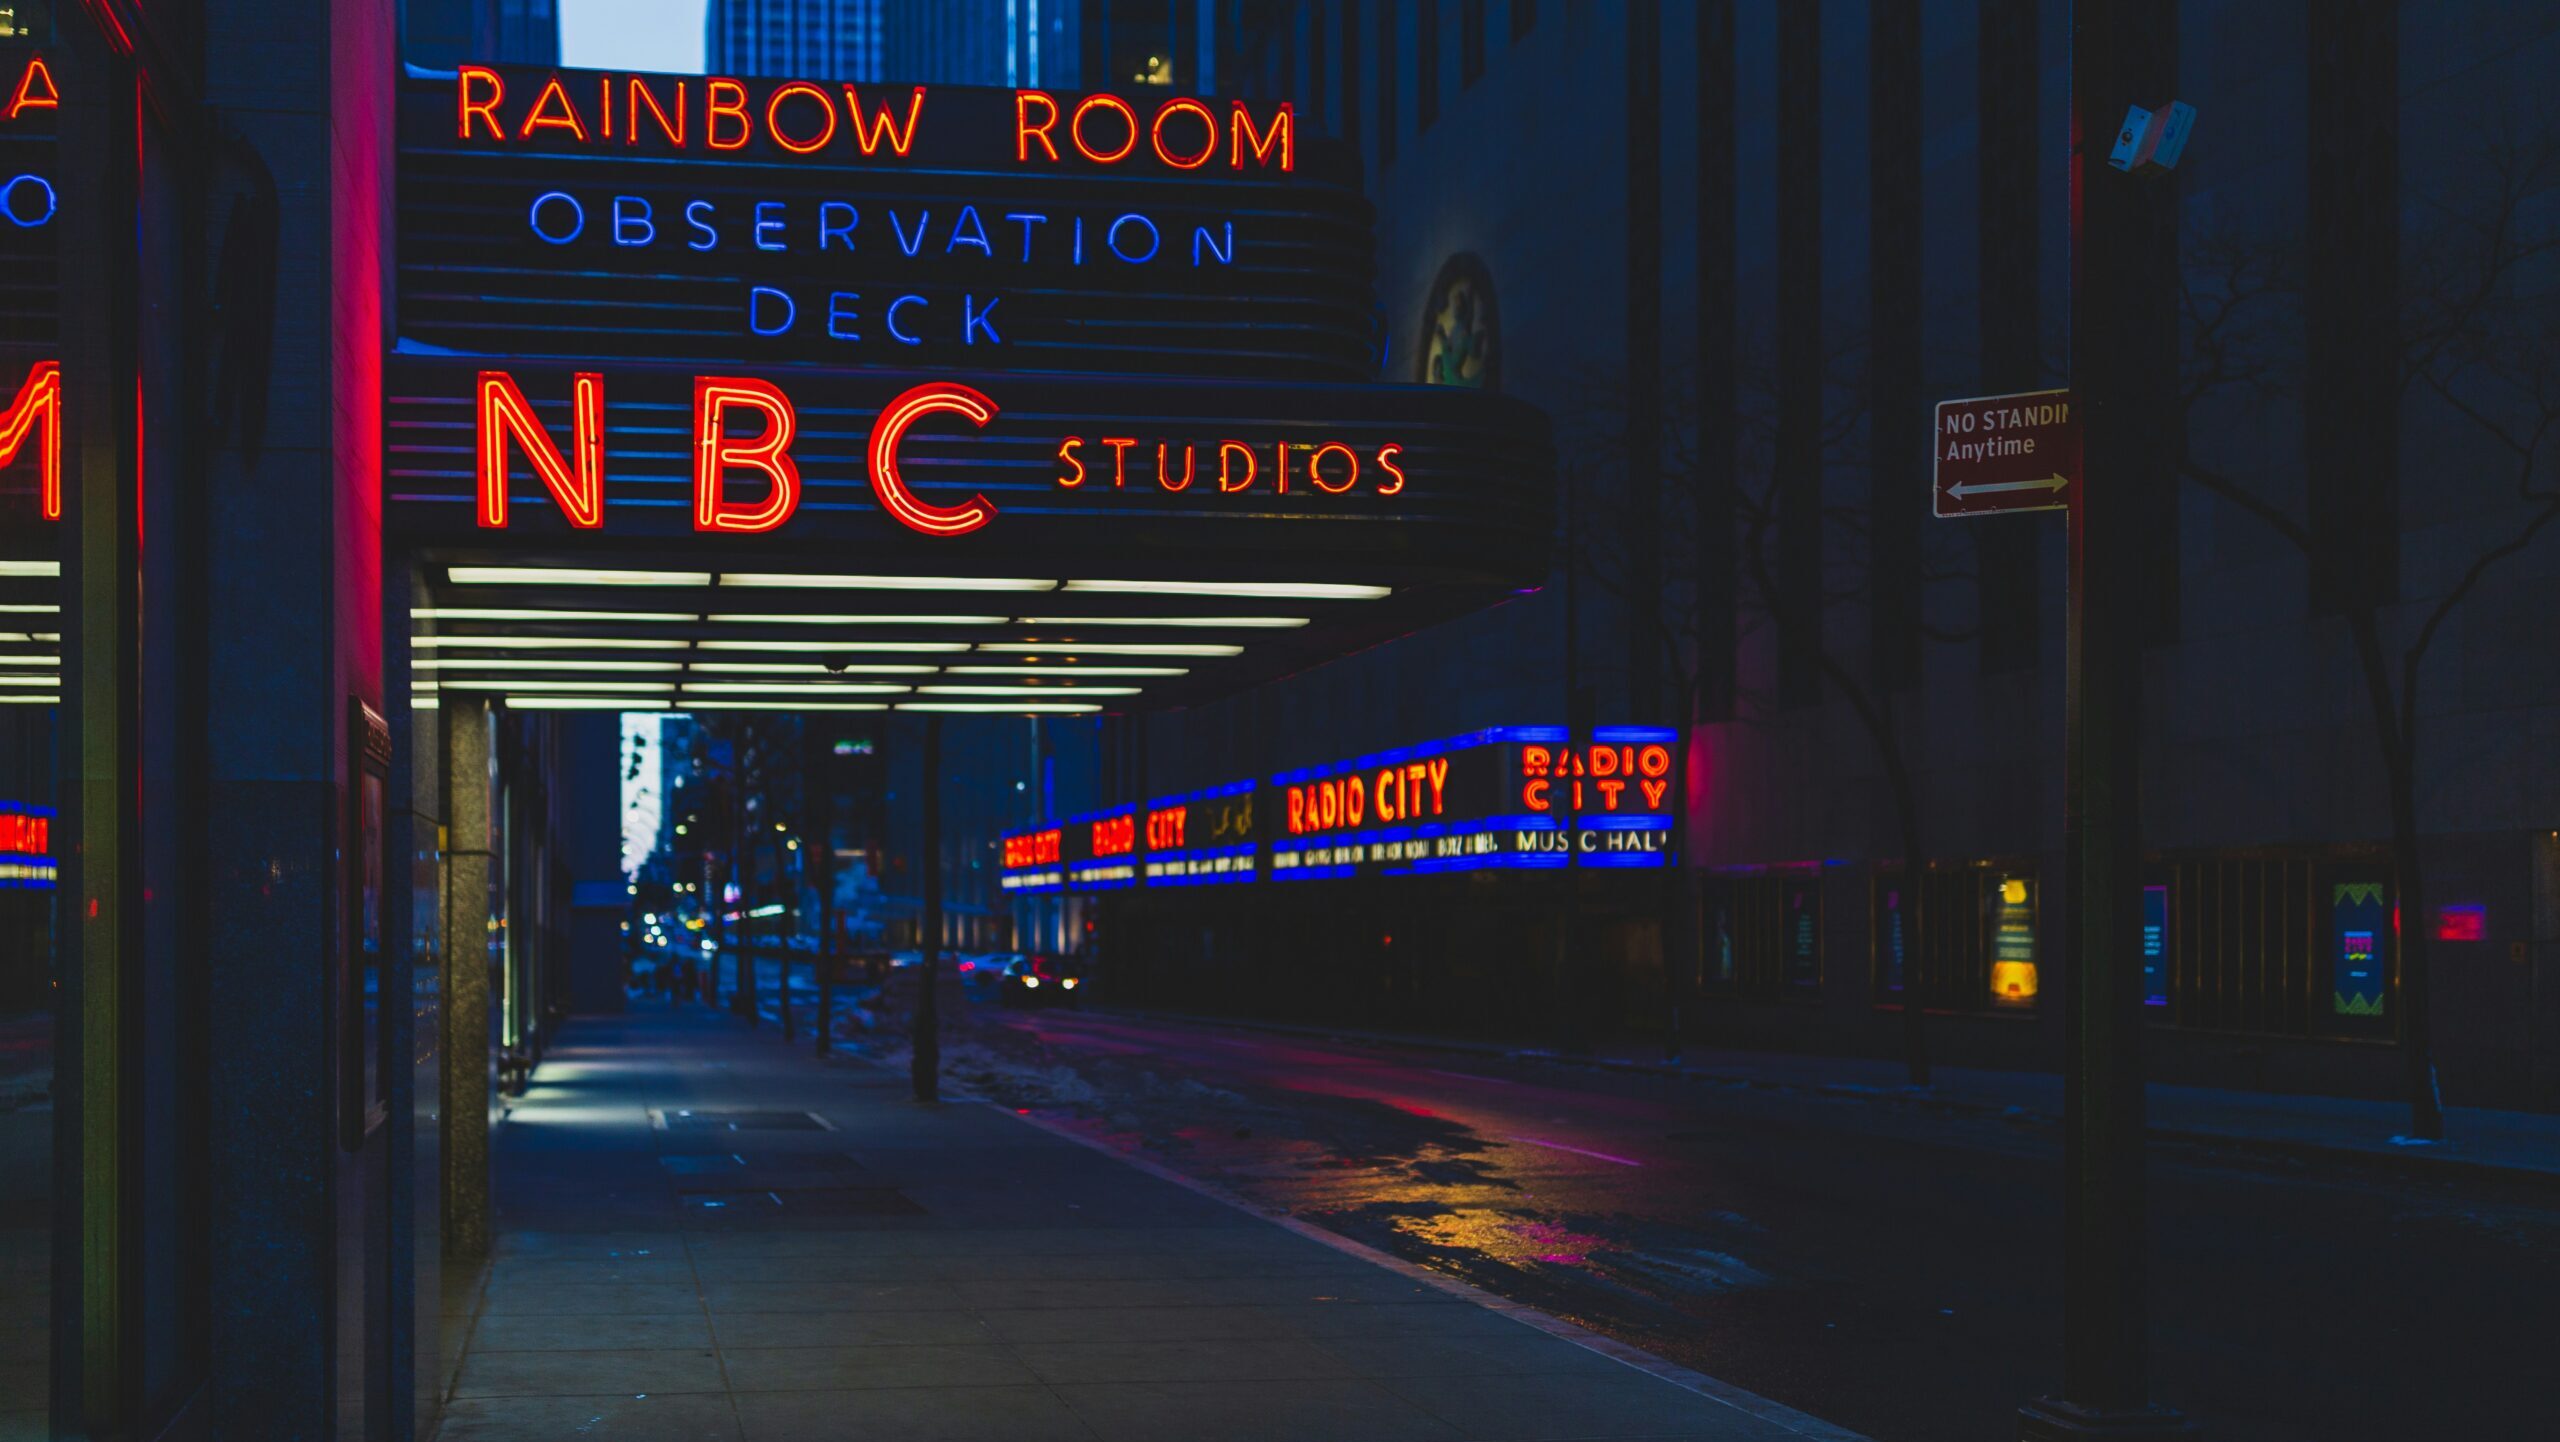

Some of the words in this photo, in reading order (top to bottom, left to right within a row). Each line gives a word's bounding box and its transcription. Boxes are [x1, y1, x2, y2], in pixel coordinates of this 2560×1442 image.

[457, 64, 927, 157] RAINBOW
[1015, 89, 1295, 172] ROOM
[529, 190, 1233, 266] OBSERVATION
[749, 285, 1001, 346] DECK
[1946, 412, 1976, 434] NO
[476, 370, 1001, 537] NBC
[1057, 435, 1405, 496] STUDIOS
[1947, 436, 2035, 463] Anytime
[1523, 744, 1670, 778] RADIO
[1287, 774, 1365, 834] RADIO
[1374, 757, 1448, 822] CITY
[1522, 778, 1667, 811] CITY
[1146, 806, 1187, 849] CITY
[1517, 831, 1597, 852] MUSC
